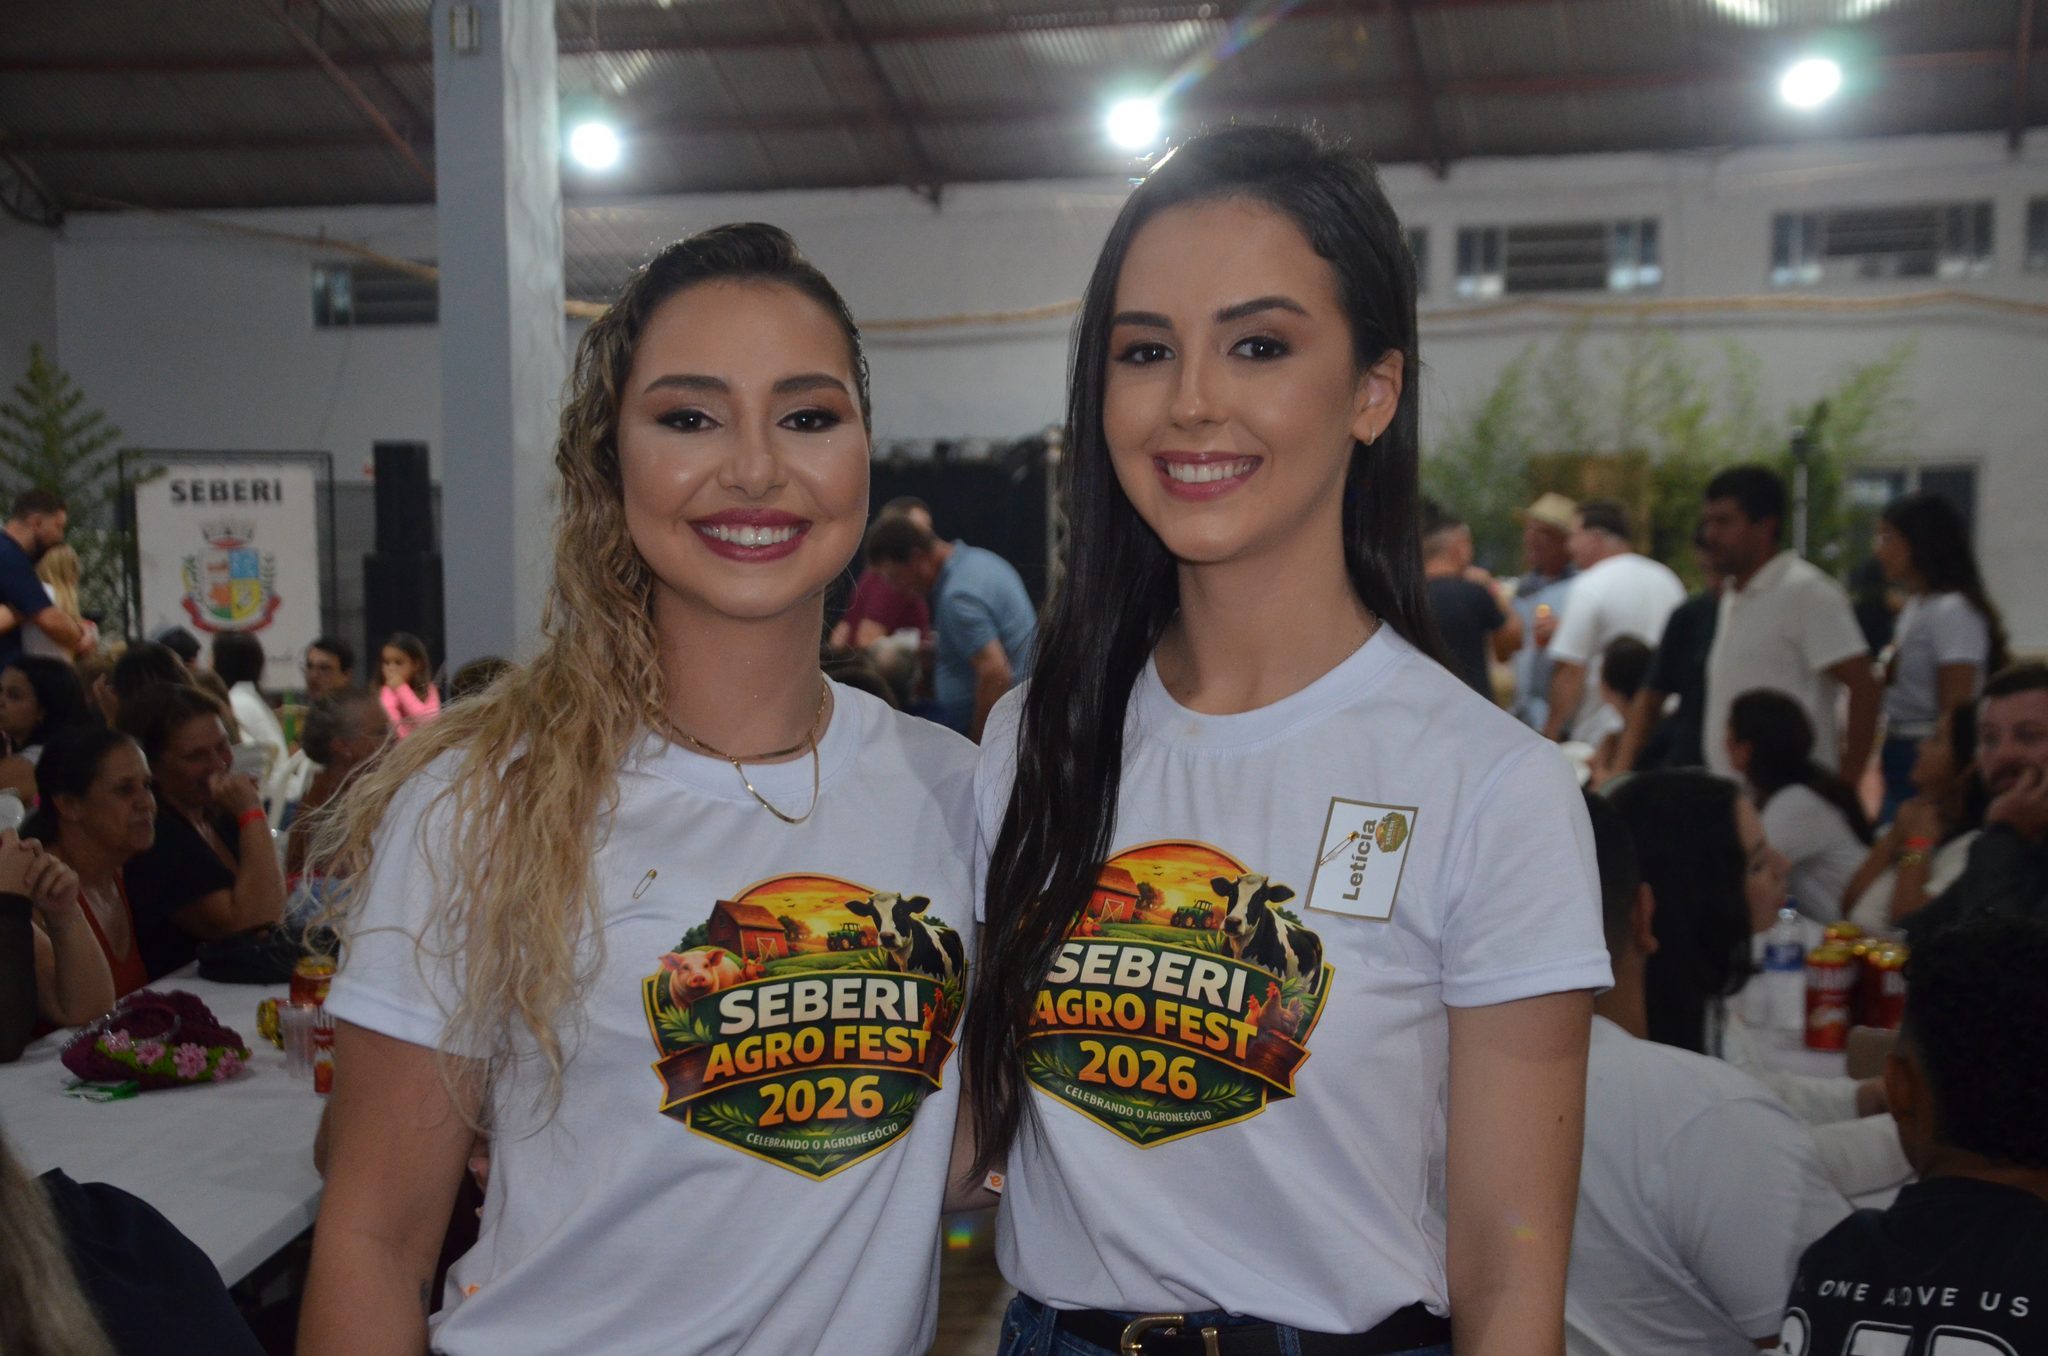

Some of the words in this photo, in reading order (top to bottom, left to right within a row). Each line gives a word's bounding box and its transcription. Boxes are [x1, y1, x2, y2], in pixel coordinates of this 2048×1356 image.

[170, 478, 283, 503] SEBERI
[1342, 819, 1377, 901] Letícia
[718, 977, 919, 1035] SEBERI
[1046, 943, 1248, 1013] SEBERI
[1028, 988, 1146, 1031] AGRO
[1154, 1000, 1258, 1060] FEST
[702, 1027, 826, 1083] AGRO
[834, 1025, 932, 1064] FEST
[1078, 1039, 1199, 1100] 2026
[758, 1074, 885, 1127] 2026
[1065, 1084, 1134, 1117] CELEBRANDO
[1136, 1108, 1144, 1119] O
[1146, 1109, 1212, 1123] AGRONEGÓCIO
[746, 1132, 809, 1150] CELEBRANDO
[812, 1139, 820, 1150] O
[823, 1122, 899, 1150] AGRONEGÓCIO
[1818, 1280, 1870, 1302] ONE
[1979, 1291, 2030, 1318] US
